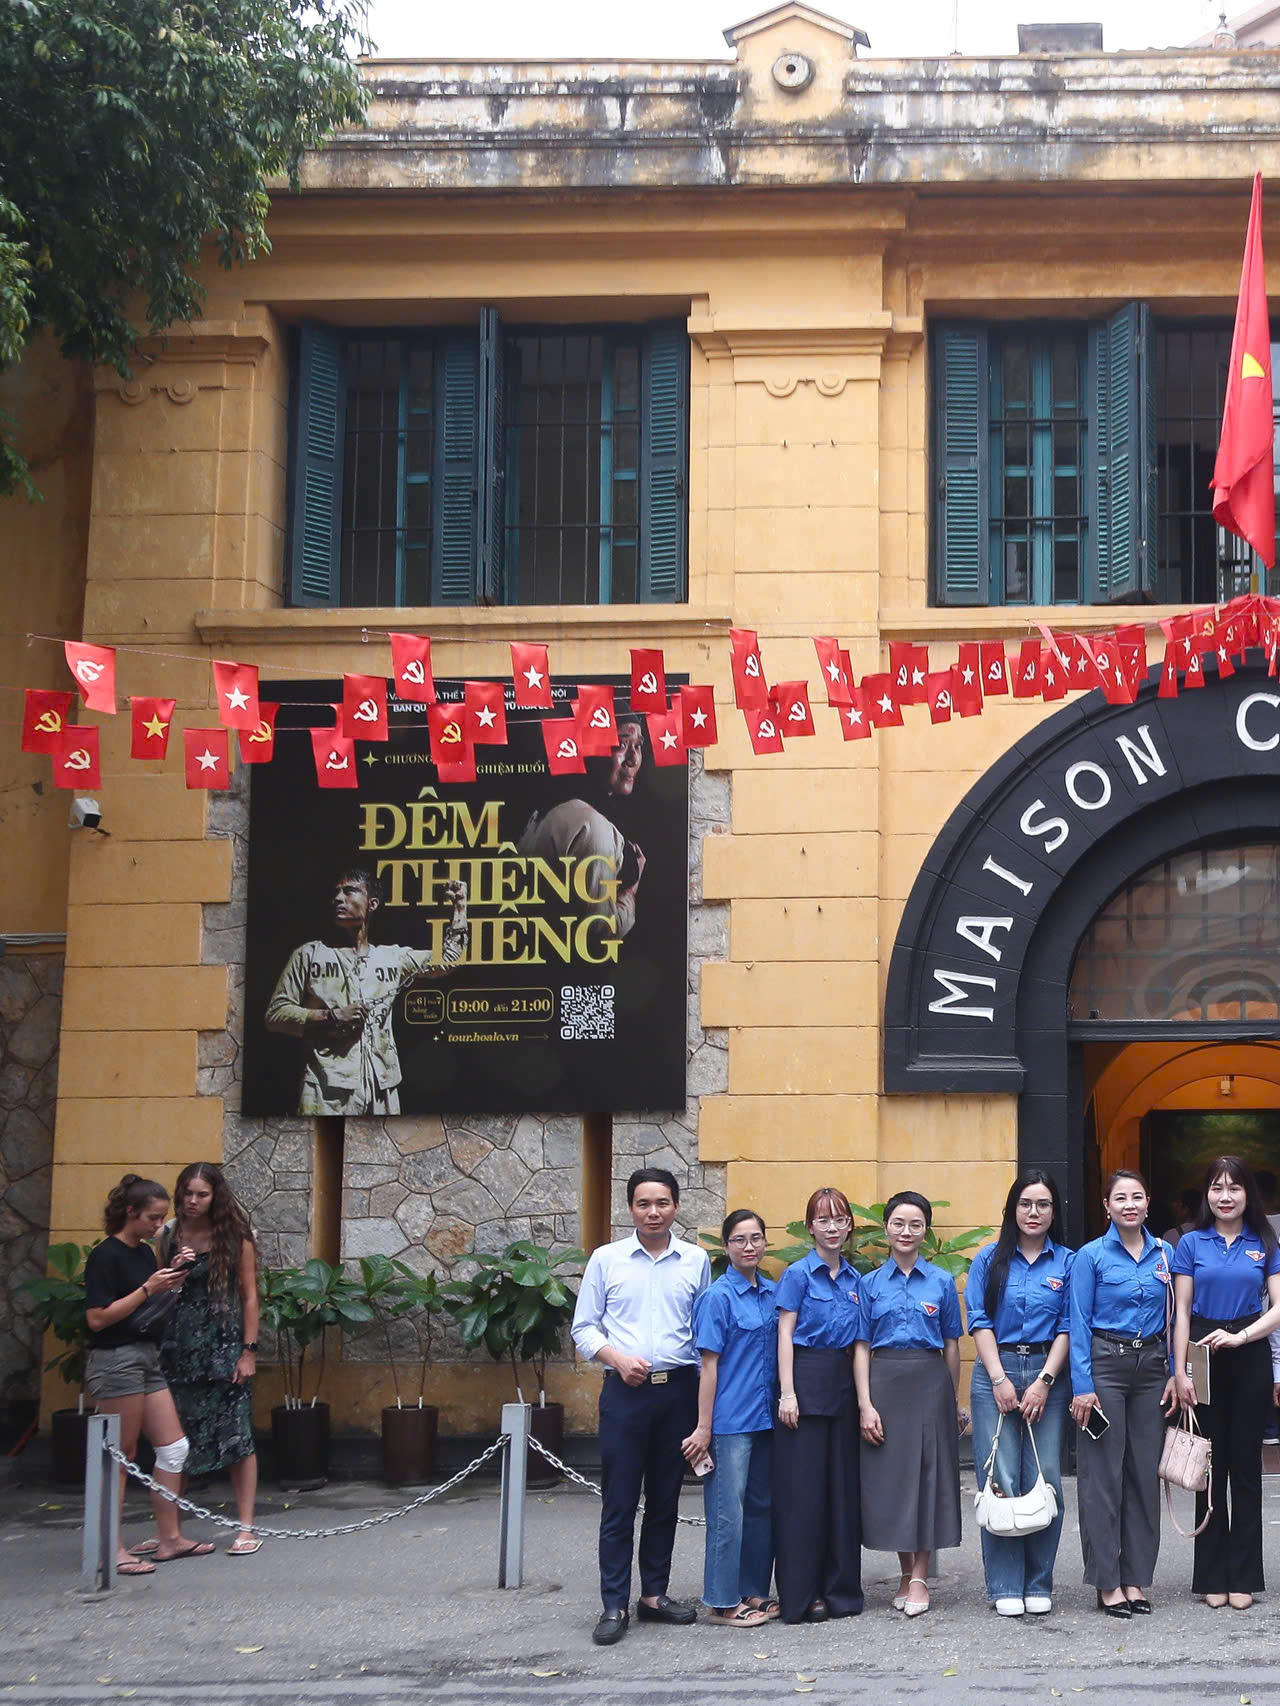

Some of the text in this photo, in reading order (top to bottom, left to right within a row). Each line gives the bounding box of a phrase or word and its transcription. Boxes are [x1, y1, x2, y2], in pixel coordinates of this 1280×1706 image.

[359, 786, 505, 850] ĐÊM
[377, 841, 622, 906] THIÊNG
[928, 723, 1169, 1023] MAISON
[426, 901, 624, 966] LIÊNG
[448, 1032, 519, 1042] tour.hoalo.vn
[451, 1000, 489, 1013] 19:00
[511, 999, 550, 1012] 21:00
